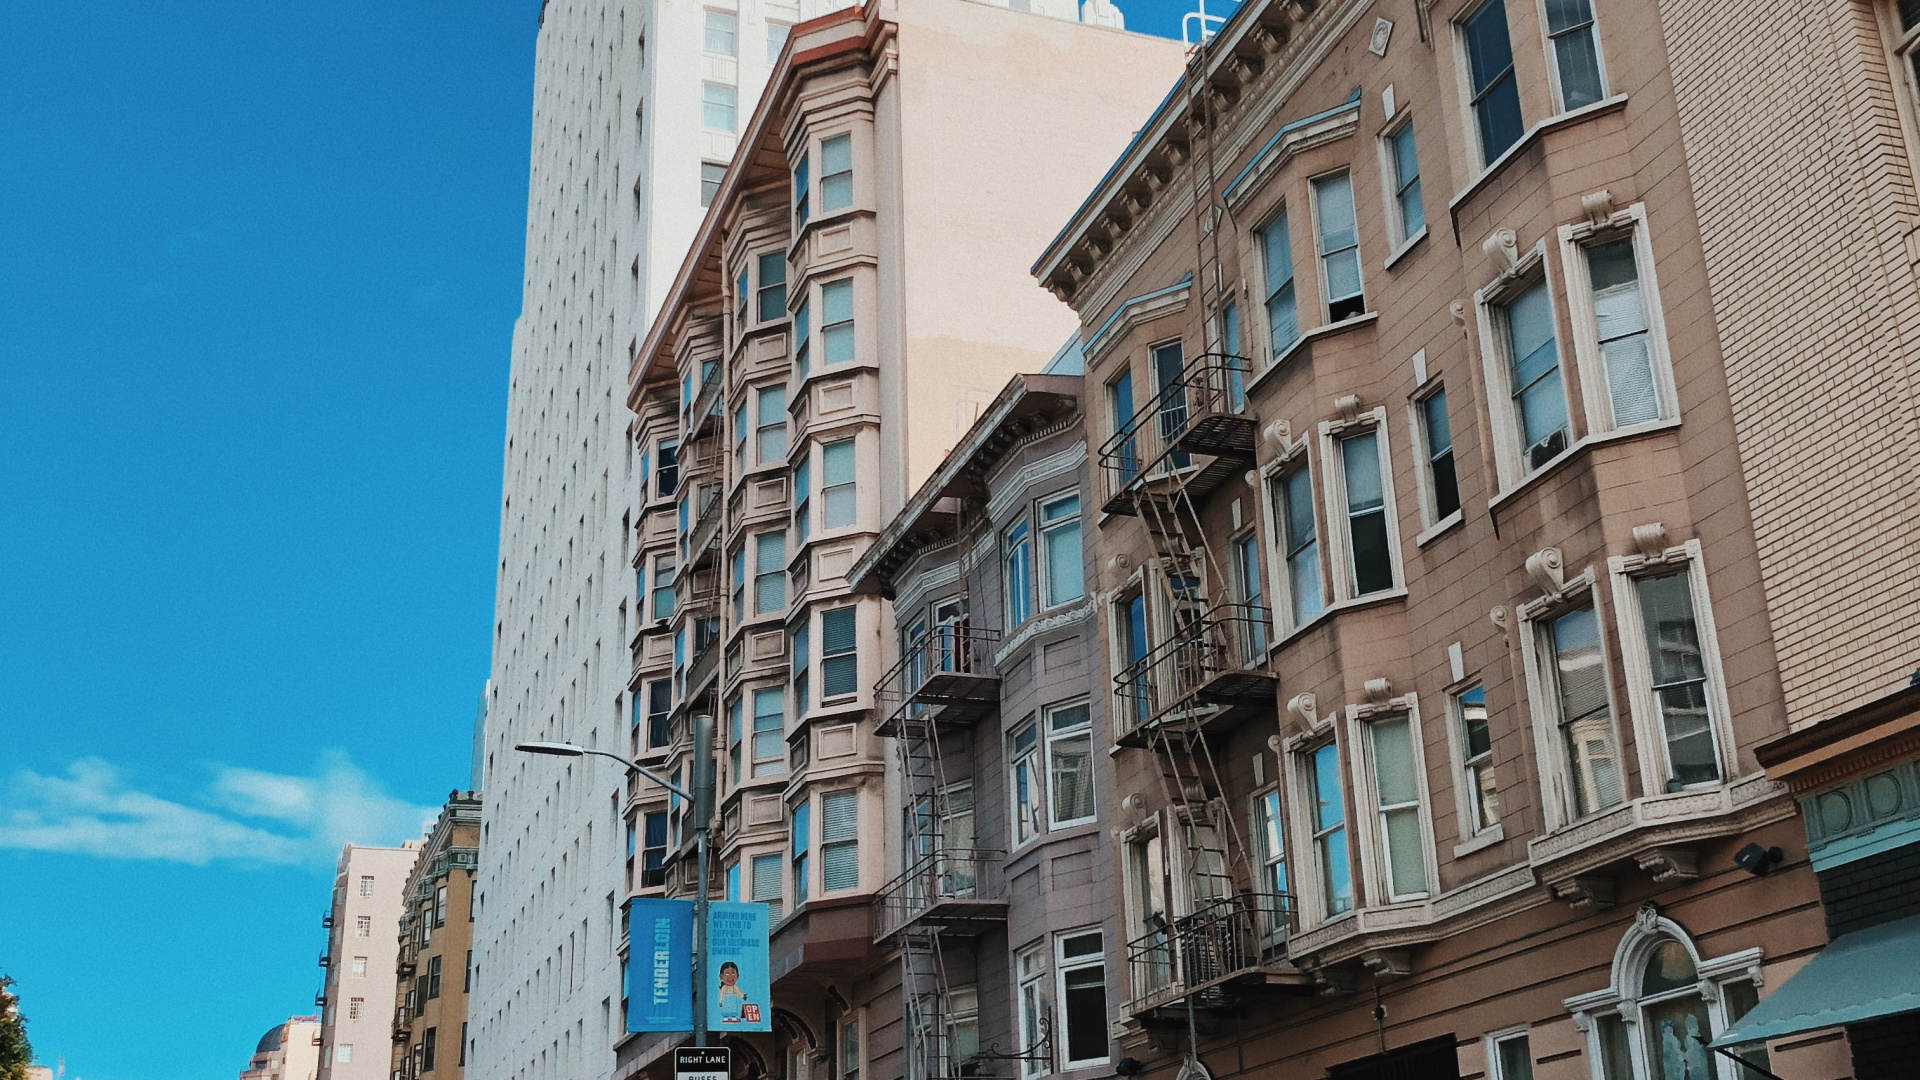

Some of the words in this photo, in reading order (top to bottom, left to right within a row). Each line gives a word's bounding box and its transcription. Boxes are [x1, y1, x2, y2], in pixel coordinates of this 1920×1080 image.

[713, 920, 723, 928] WE
[725, 921, 741, 929] TEND
[743, 921, 752, 929] TO
[712, 929, 743, 937] SUPPORT
[712, 938, 726, 946] OUR
[728, 938, 760, 947] BUSINESS
[653, 917, 671, 1006] TENDERLOIN
[679, 1056, 703, 1064] RIGHT
[705, 1055, 726, 1063] LANE
